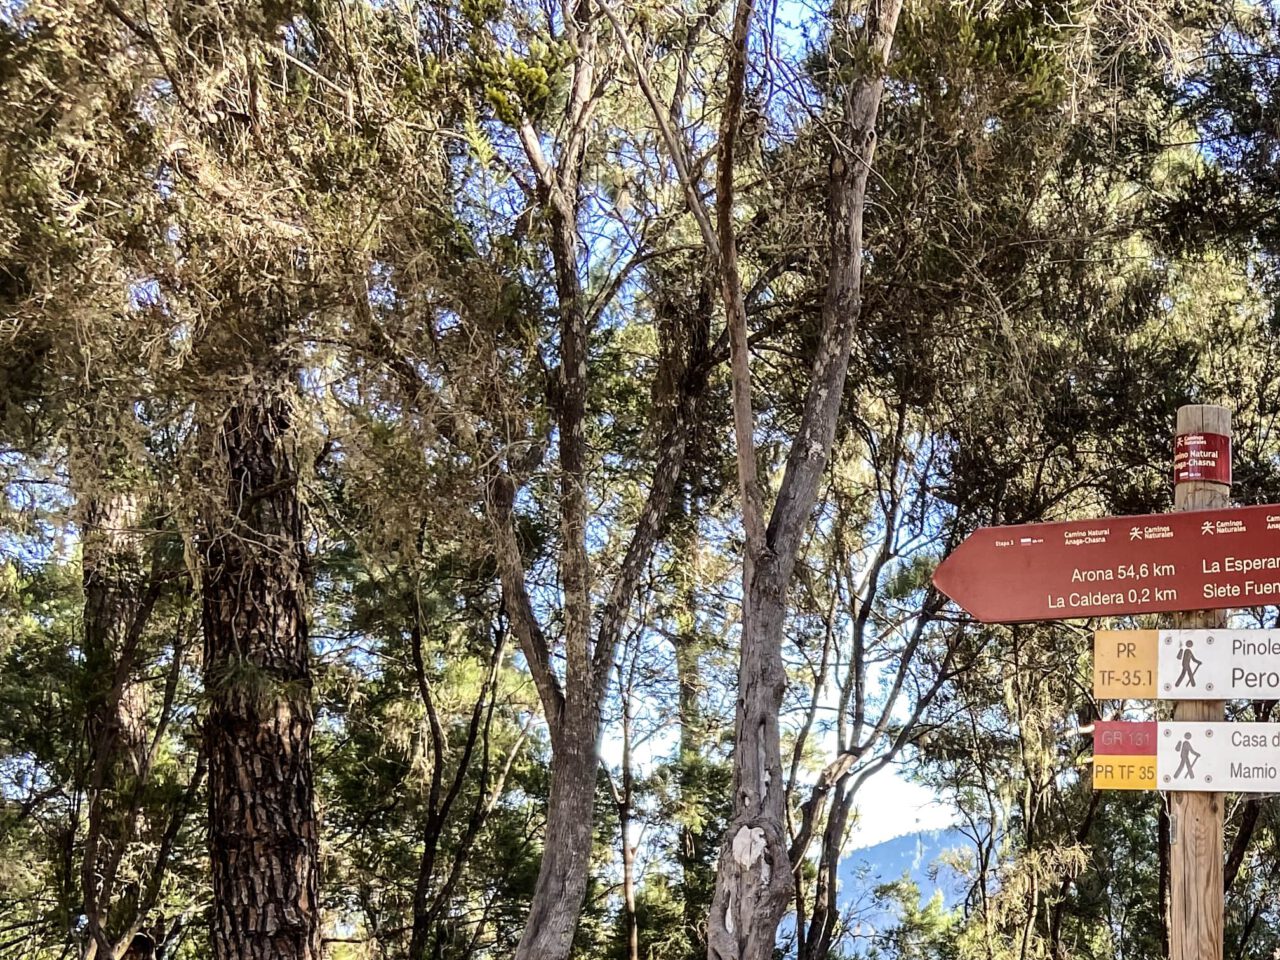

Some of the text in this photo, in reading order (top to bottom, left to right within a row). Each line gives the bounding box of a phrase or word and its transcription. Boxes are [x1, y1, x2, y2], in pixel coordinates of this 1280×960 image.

[1190, 450, 1219, 459] Natural
[1144, 525, 1170, 533] Caminos
[1216, 520, 1243, 528] Caminos
[1216, 525, 1247, 534] Naturales
[1064, 528, 1110, 538] Camino Natural
[1065, 536, 1106, 546] Anaga-Chasna
[1144, 531, 1174, 539] Naturales
[1071, 562, 1176, 583] Arona 54,6 km
[1202, 558, 1221, 574] La
[1048, 587, 1177, 609] La Caldera 0,2 km
[1203, 582, 1241, 599] Siete
[1116, 643, 1136, 658] PR
[1100, 669, 1153, 686] TF-35.1
[1231, 667, 1280, 689] Pero
[1102, 730, 1151, 747] GR 131
[1231, 731, 1269, 749] Casa
[1095, 764, 1155, 780] PR TF 35
[1230, 762, 1277, 780] Mamio
